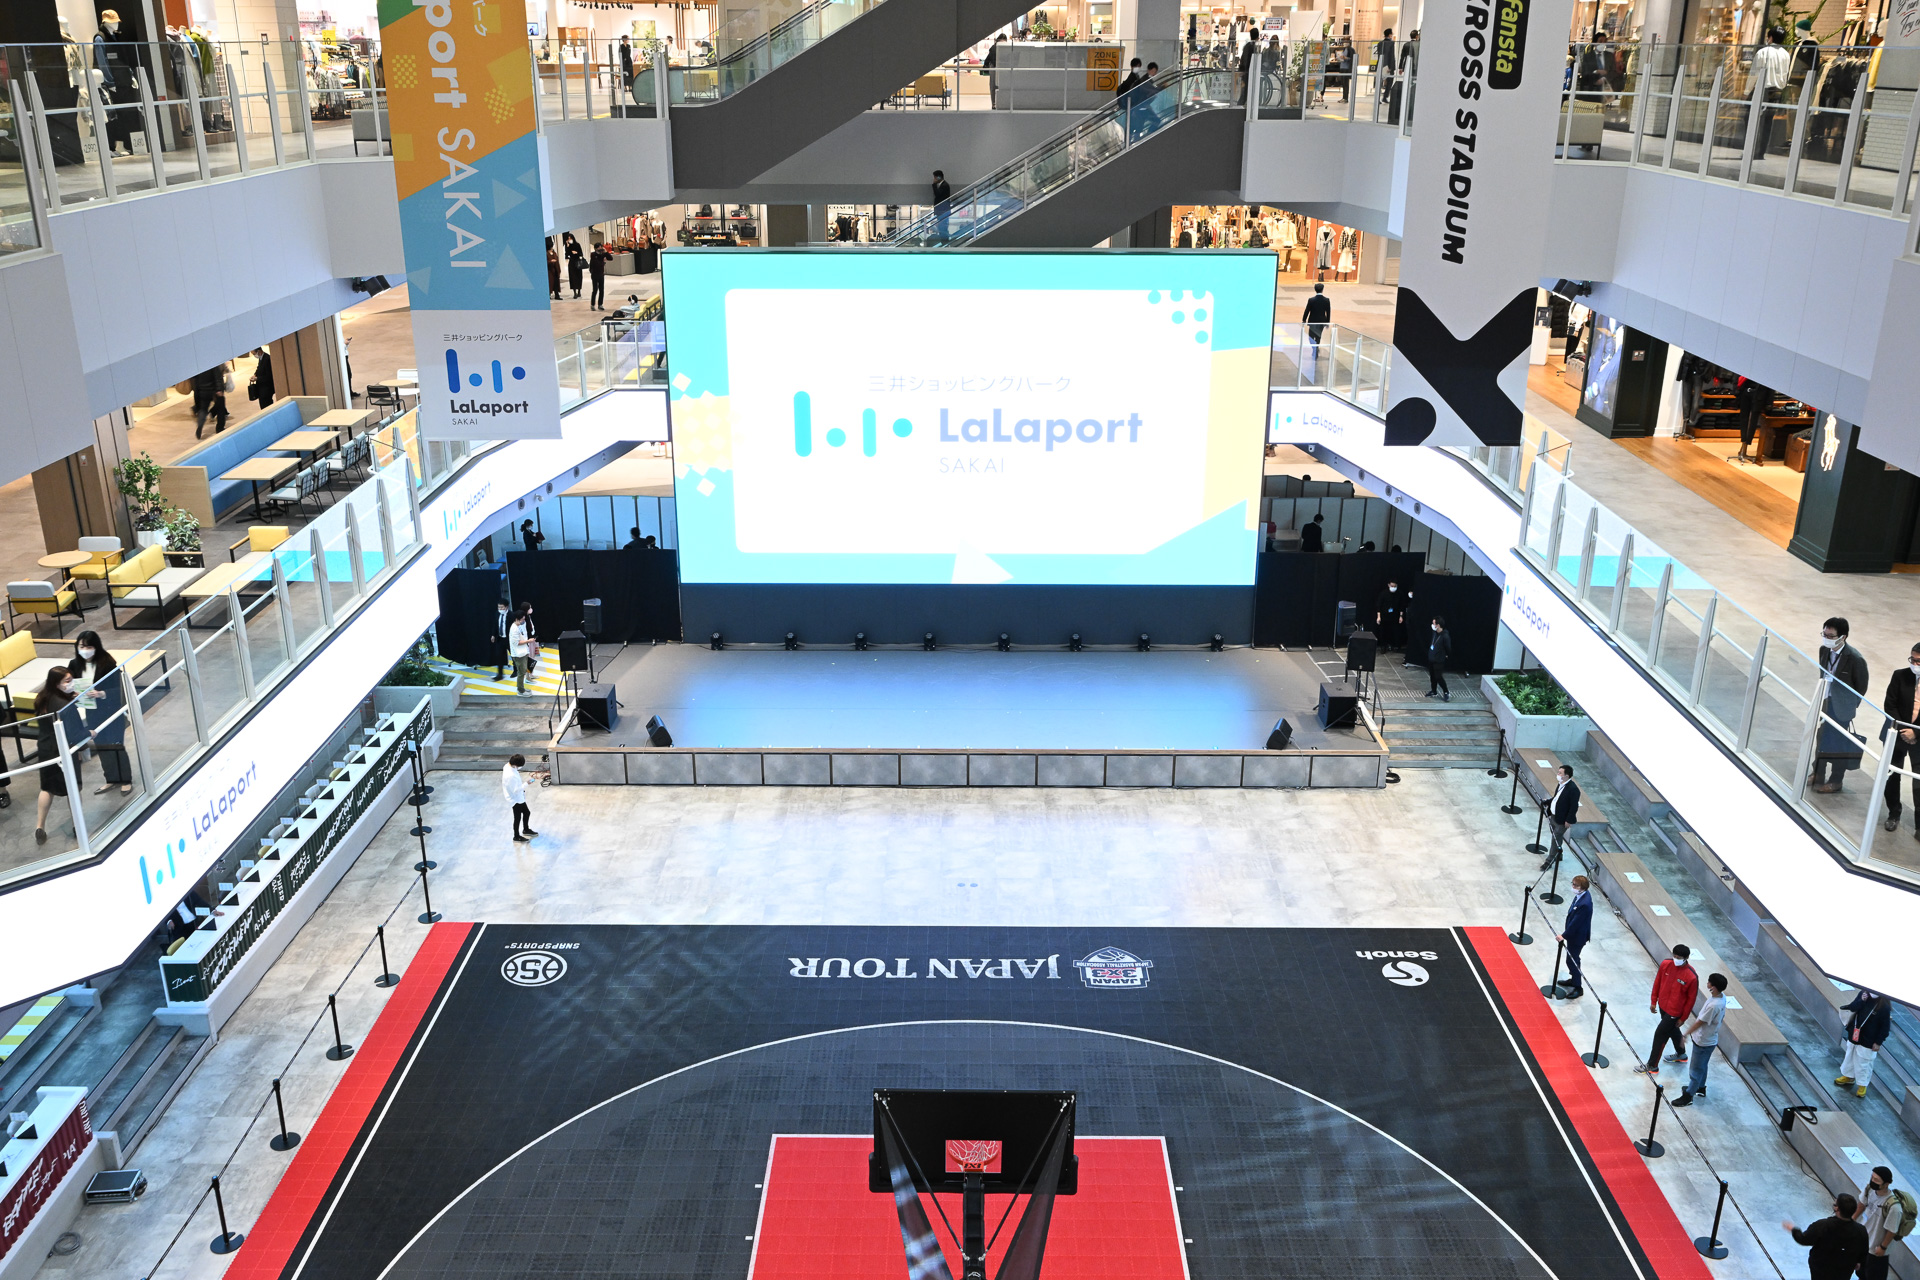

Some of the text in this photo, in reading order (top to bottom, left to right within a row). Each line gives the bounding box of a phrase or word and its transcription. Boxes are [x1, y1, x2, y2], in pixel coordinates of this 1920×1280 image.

[1094, 51, 1117, 59] ZONE
[1093, 58, 1117, 91] B
[1441, 0, 1491, 265] ROSS STADIUM
[437, 127, 487, 268] SAKAI
[443, 333, 524, 342] 三井ショッピングパーク
[449, 399, 529, 417] LaLaport
[451, 418, 478, 426] SAKAI
[939, 407, 1143, 452] LaLaport
[1302, 412, 1344, 438] LaLaport
[938, 457, 1005, 474] SAKAI
[1512, 585, 1551, 640] LaLaport
[192, 760, 257, 841] LaLaport
[509, 942, 580, 950] SNAPSPORTS
[1355, 950, 1439, 961] Senoh
[787, 953, 1062, 979] JAPAN TOUR
